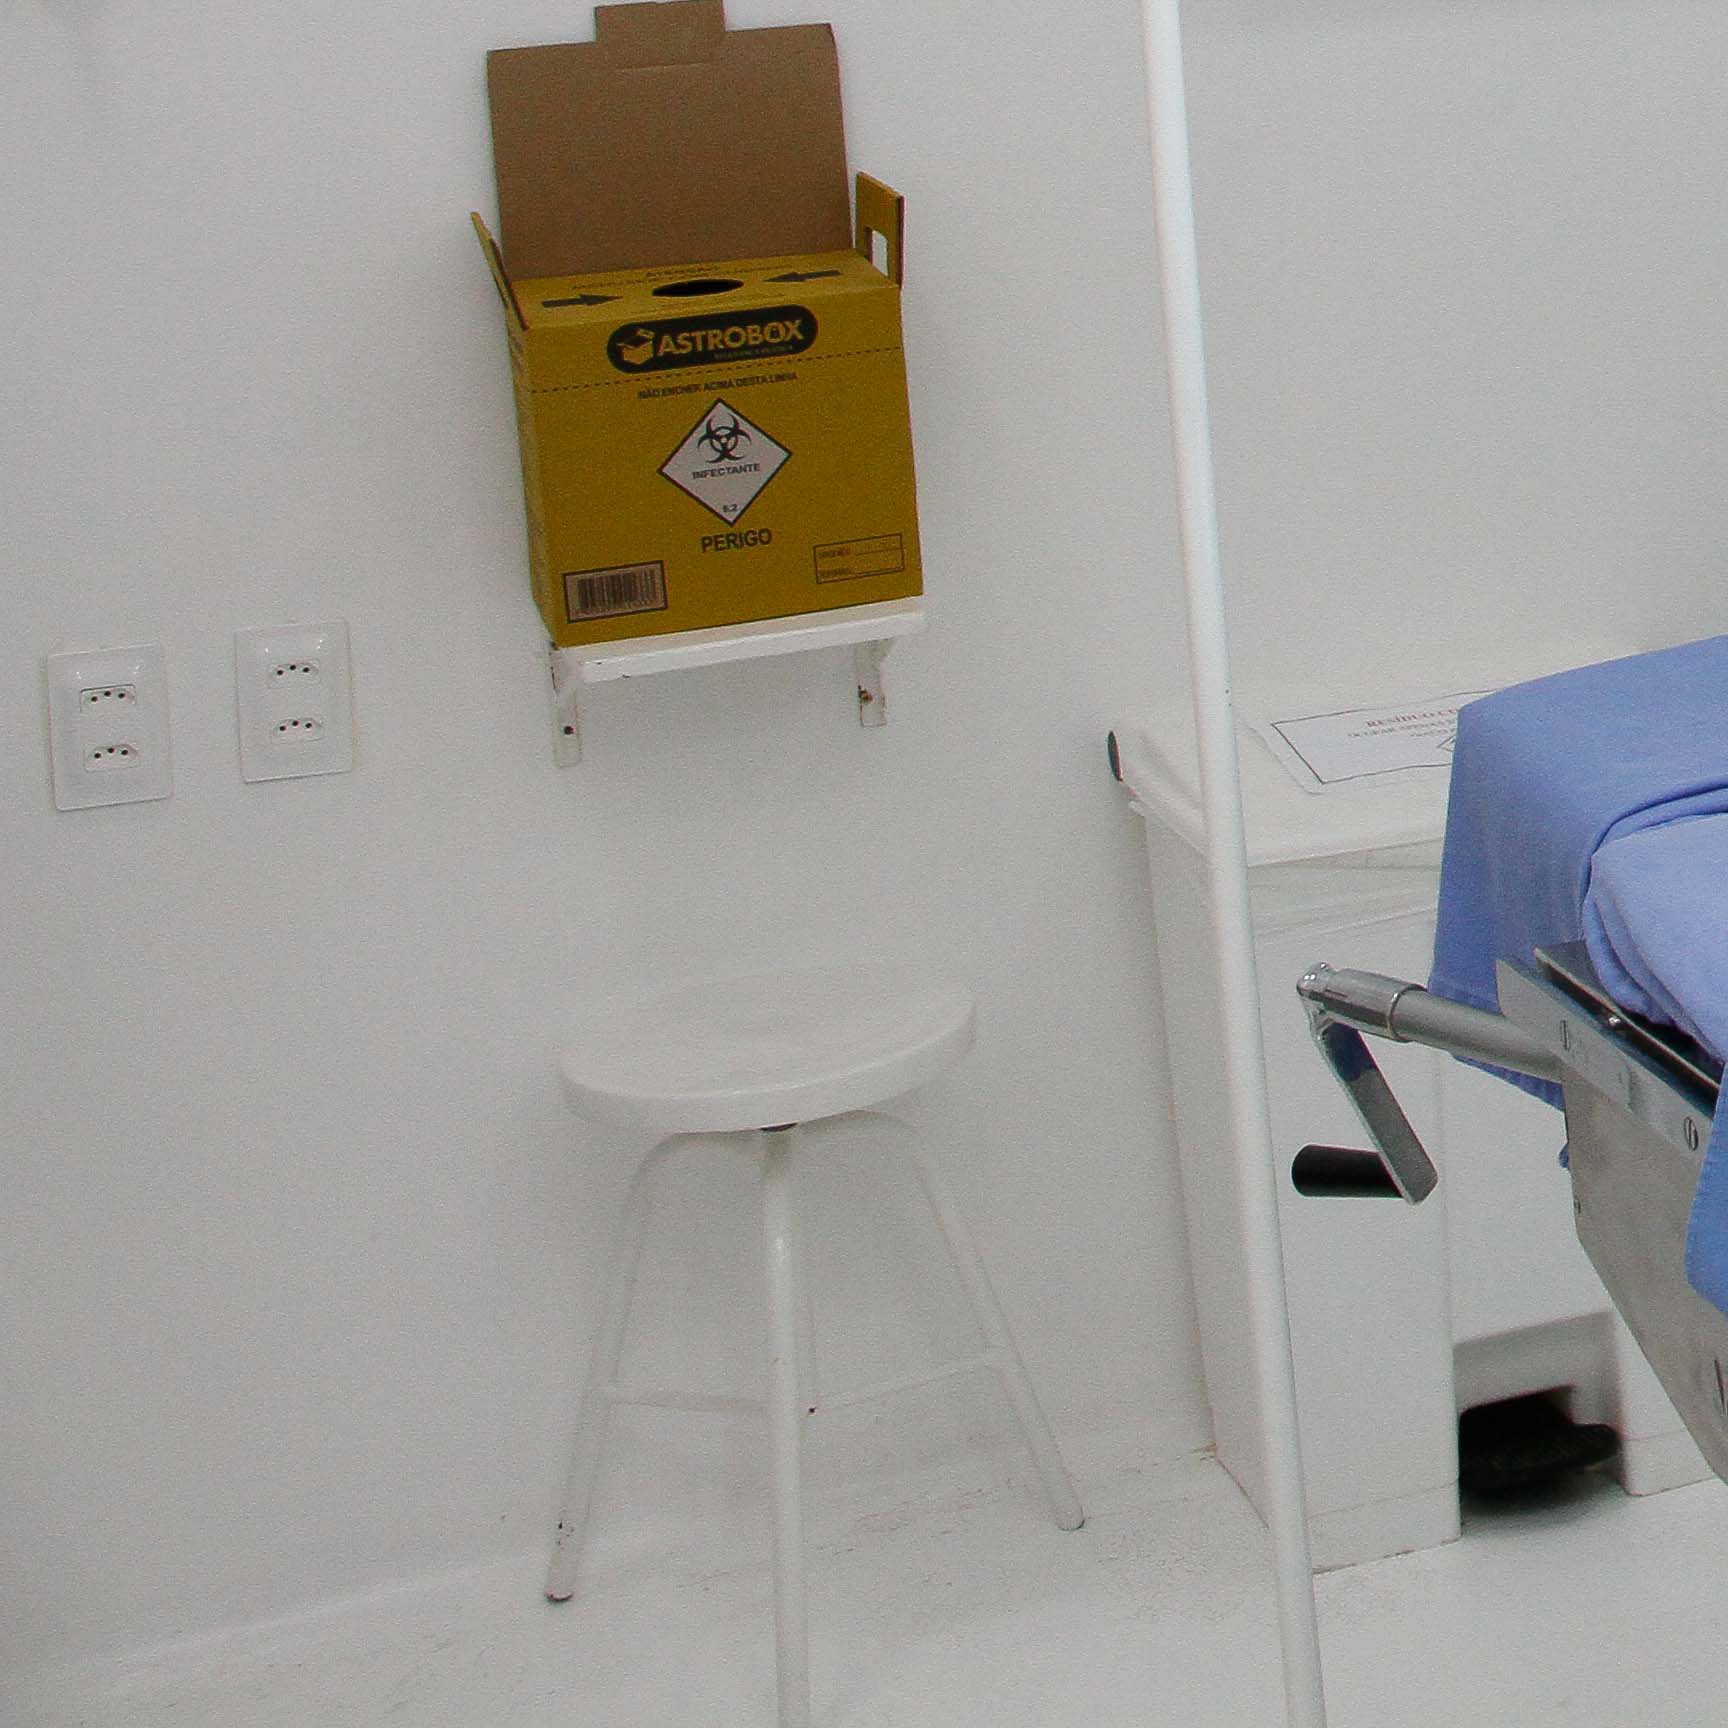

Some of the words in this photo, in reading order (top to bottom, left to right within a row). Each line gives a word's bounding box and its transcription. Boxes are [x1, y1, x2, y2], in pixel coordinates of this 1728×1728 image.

[657, 318, 805, 356] ASTROBOX
[703, 378, 735, 392] ACIMA
[692, 462, 760, 480] INFECTANTE
[701, 527, 773, 553] PERIGO
